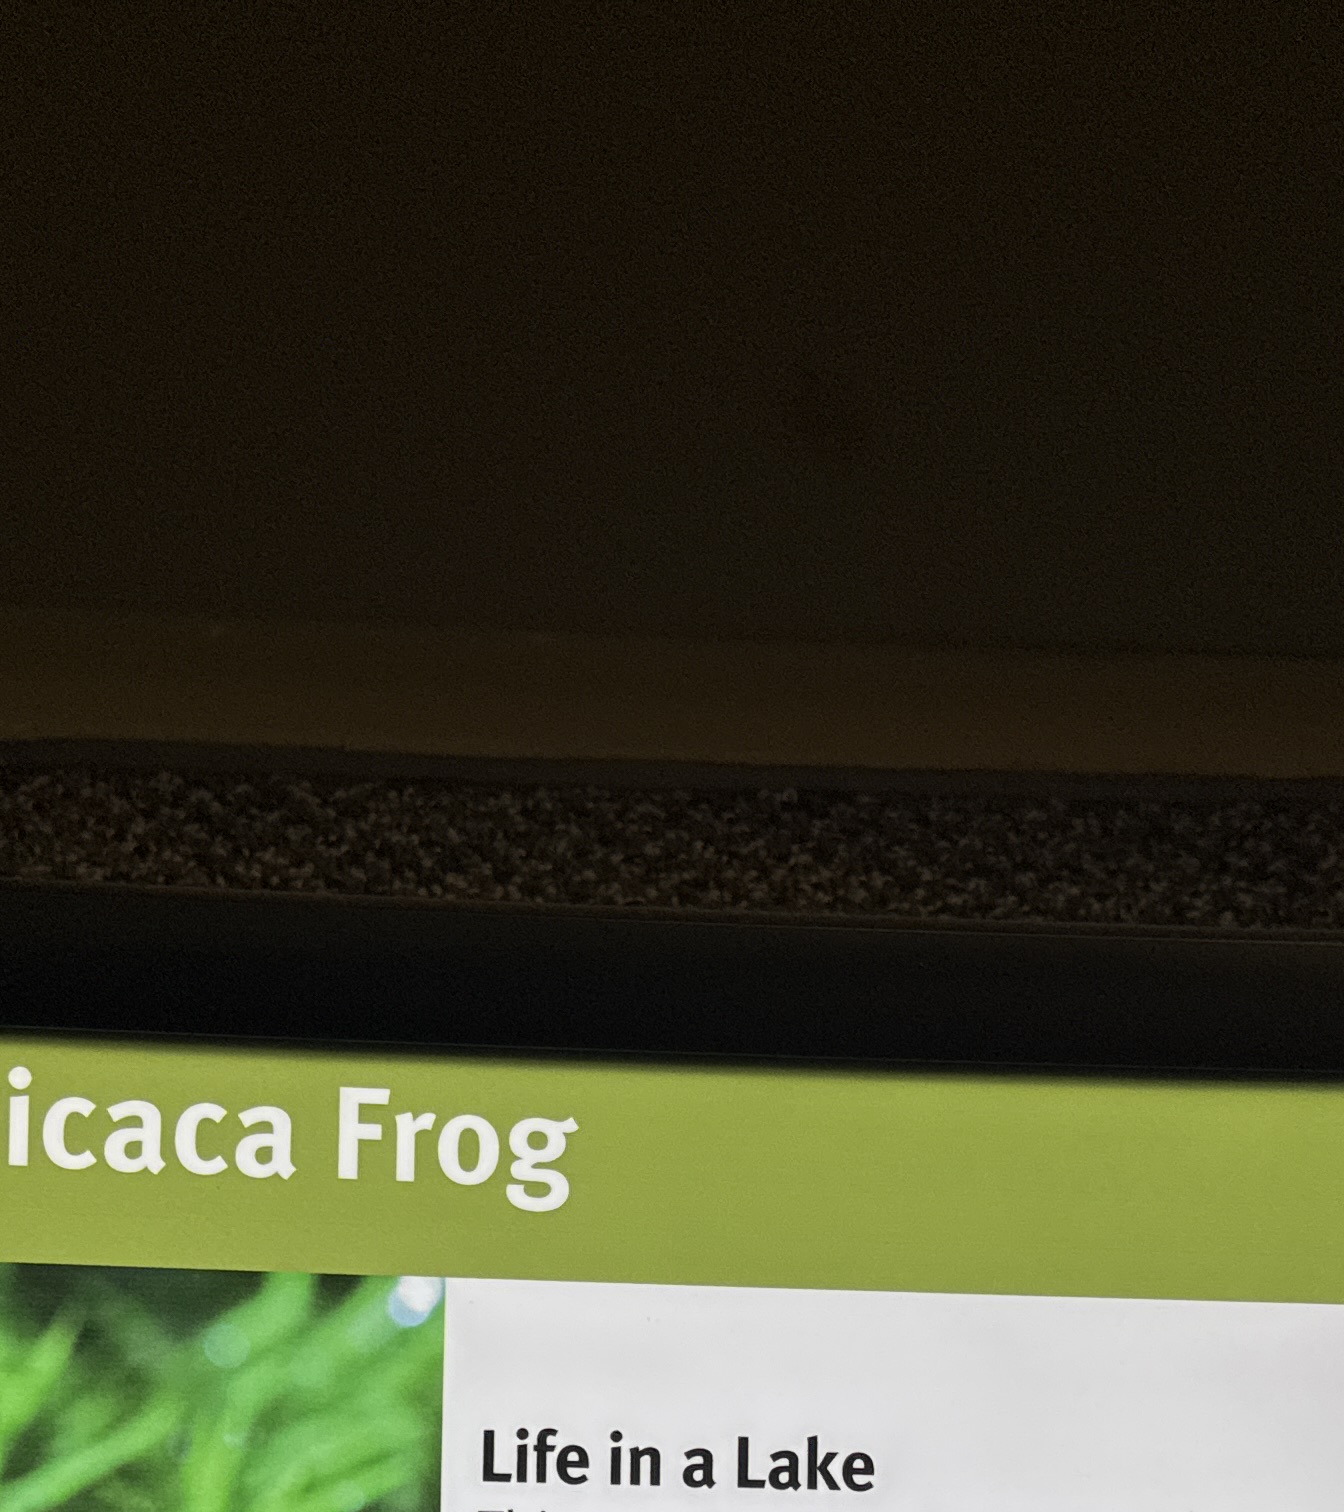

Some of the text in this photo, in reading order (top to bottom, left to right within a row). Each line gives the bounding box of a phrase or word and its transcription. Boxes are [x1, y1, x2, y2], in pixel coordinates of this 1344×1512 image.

[337, 1086, 580, 1213] Frog
[482, 1427, 875, 1492] Life in a Lake
